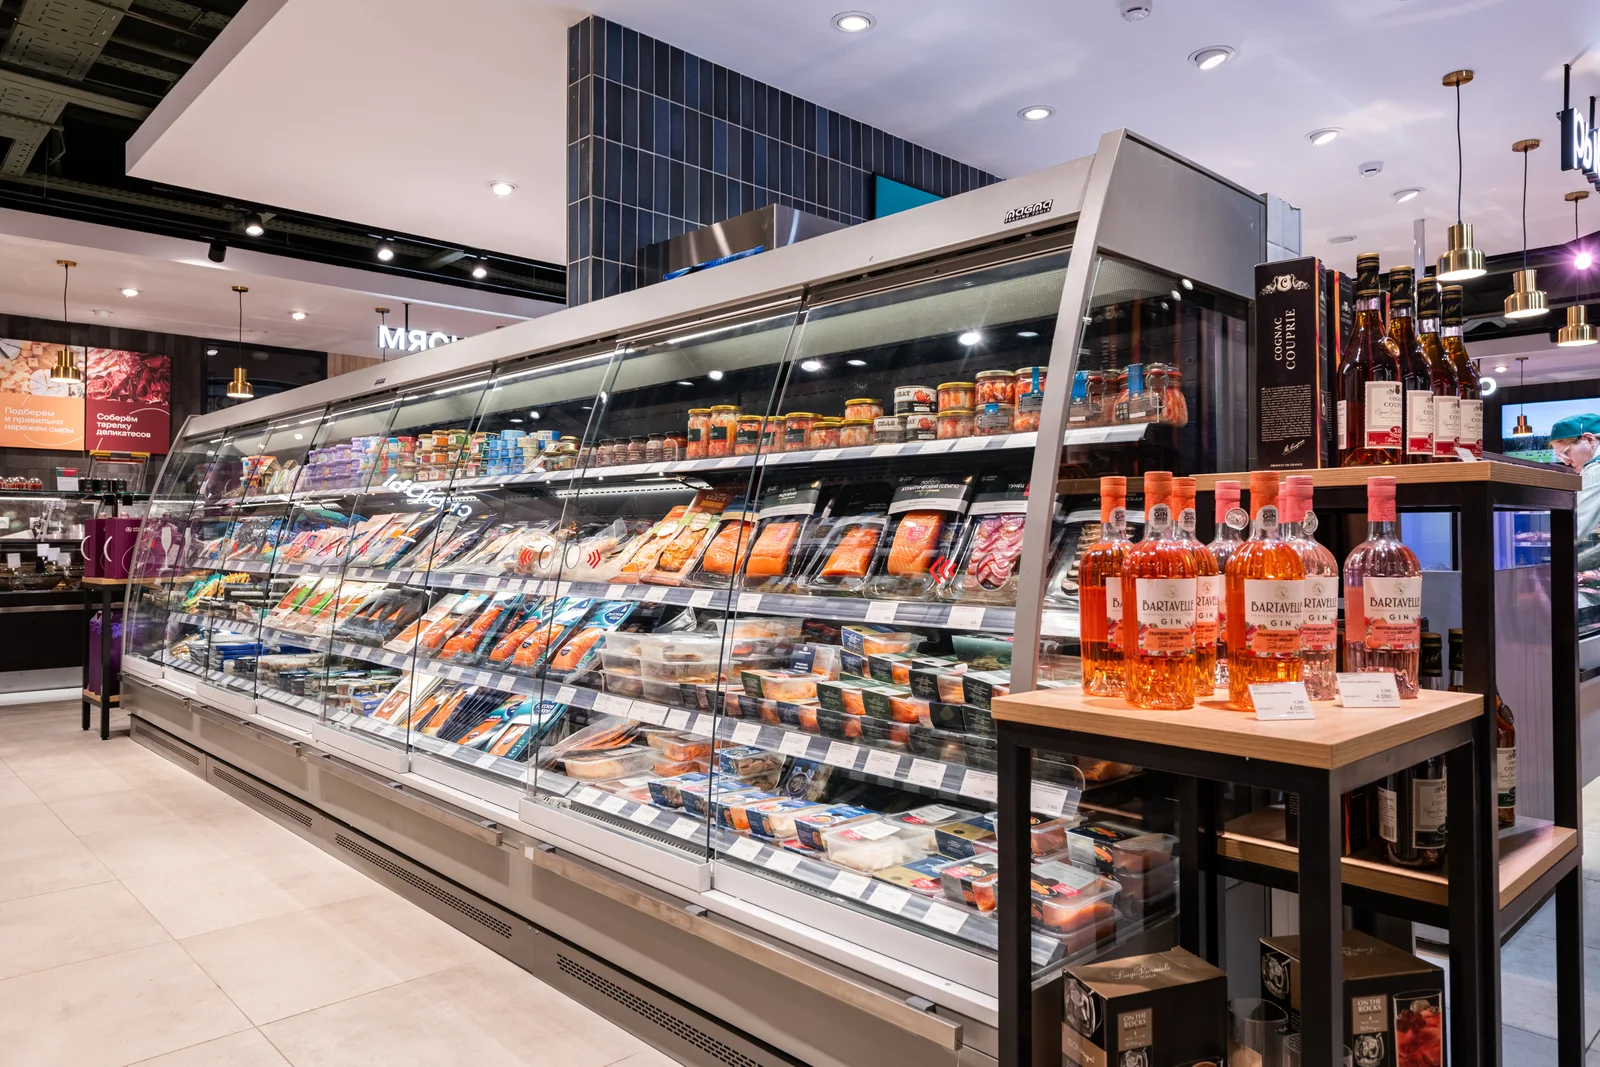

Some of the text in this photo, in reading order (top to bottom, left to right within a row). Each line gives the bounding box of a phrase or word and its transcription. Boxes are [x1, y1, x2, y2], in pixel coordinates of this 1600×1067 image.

[1274, 317, 1282, 361] COGNAC
[1285, 308, 1296, 370] COUPRIE
[4, 406, 55, 417] Подберём
[12, 417, 63, 426] правильно
[96, 412, 138, 423] Соберём
[4, 424, 48, 432] нарежем
[96, 421, 132, 430] тарелку
[96, 429, 151, 438] деликатесов
[1142, 600, 1194, 612] BARTAVELLE
[1251, 601, 1302, 613] BARTAVELLE
[1304, 598, 1337, 608] RTAVELLE
[1370, 597, 1419, 607] BARTAVELLE
[1358, 1004, 1382, 1013] ROCKS
[1123, 1012, 1146, 1022] ON THE
[1123, 1019, 1147, 1028] ROCKS
